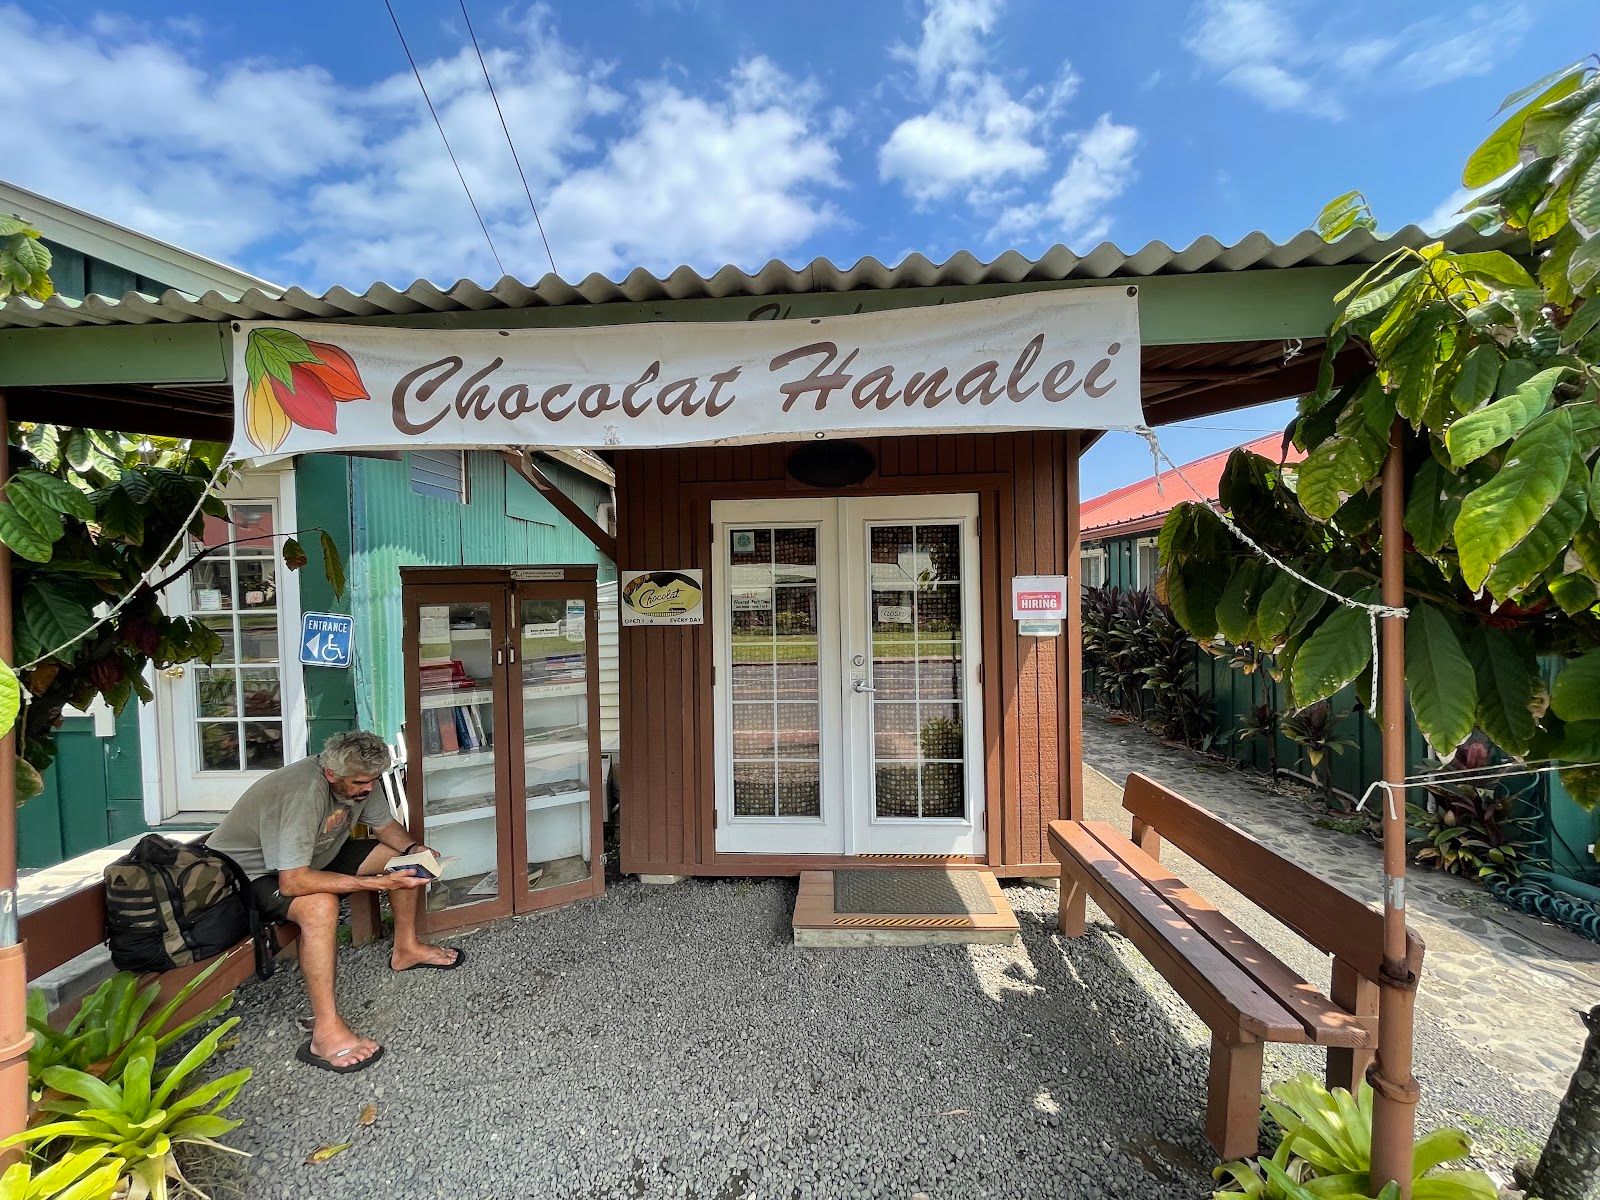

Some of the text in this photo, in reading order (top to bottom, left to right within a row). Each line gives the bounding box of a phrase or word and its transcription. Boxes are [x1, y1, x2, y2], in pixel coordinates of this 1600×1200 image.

[391, 332, 1122, 436] Chocolat Hanalei
[638, 588, 686, 609] Chocolat
[1021, 599, 1057, 609] HIRING
[308, 619, 348, 633] ENTRANCE
